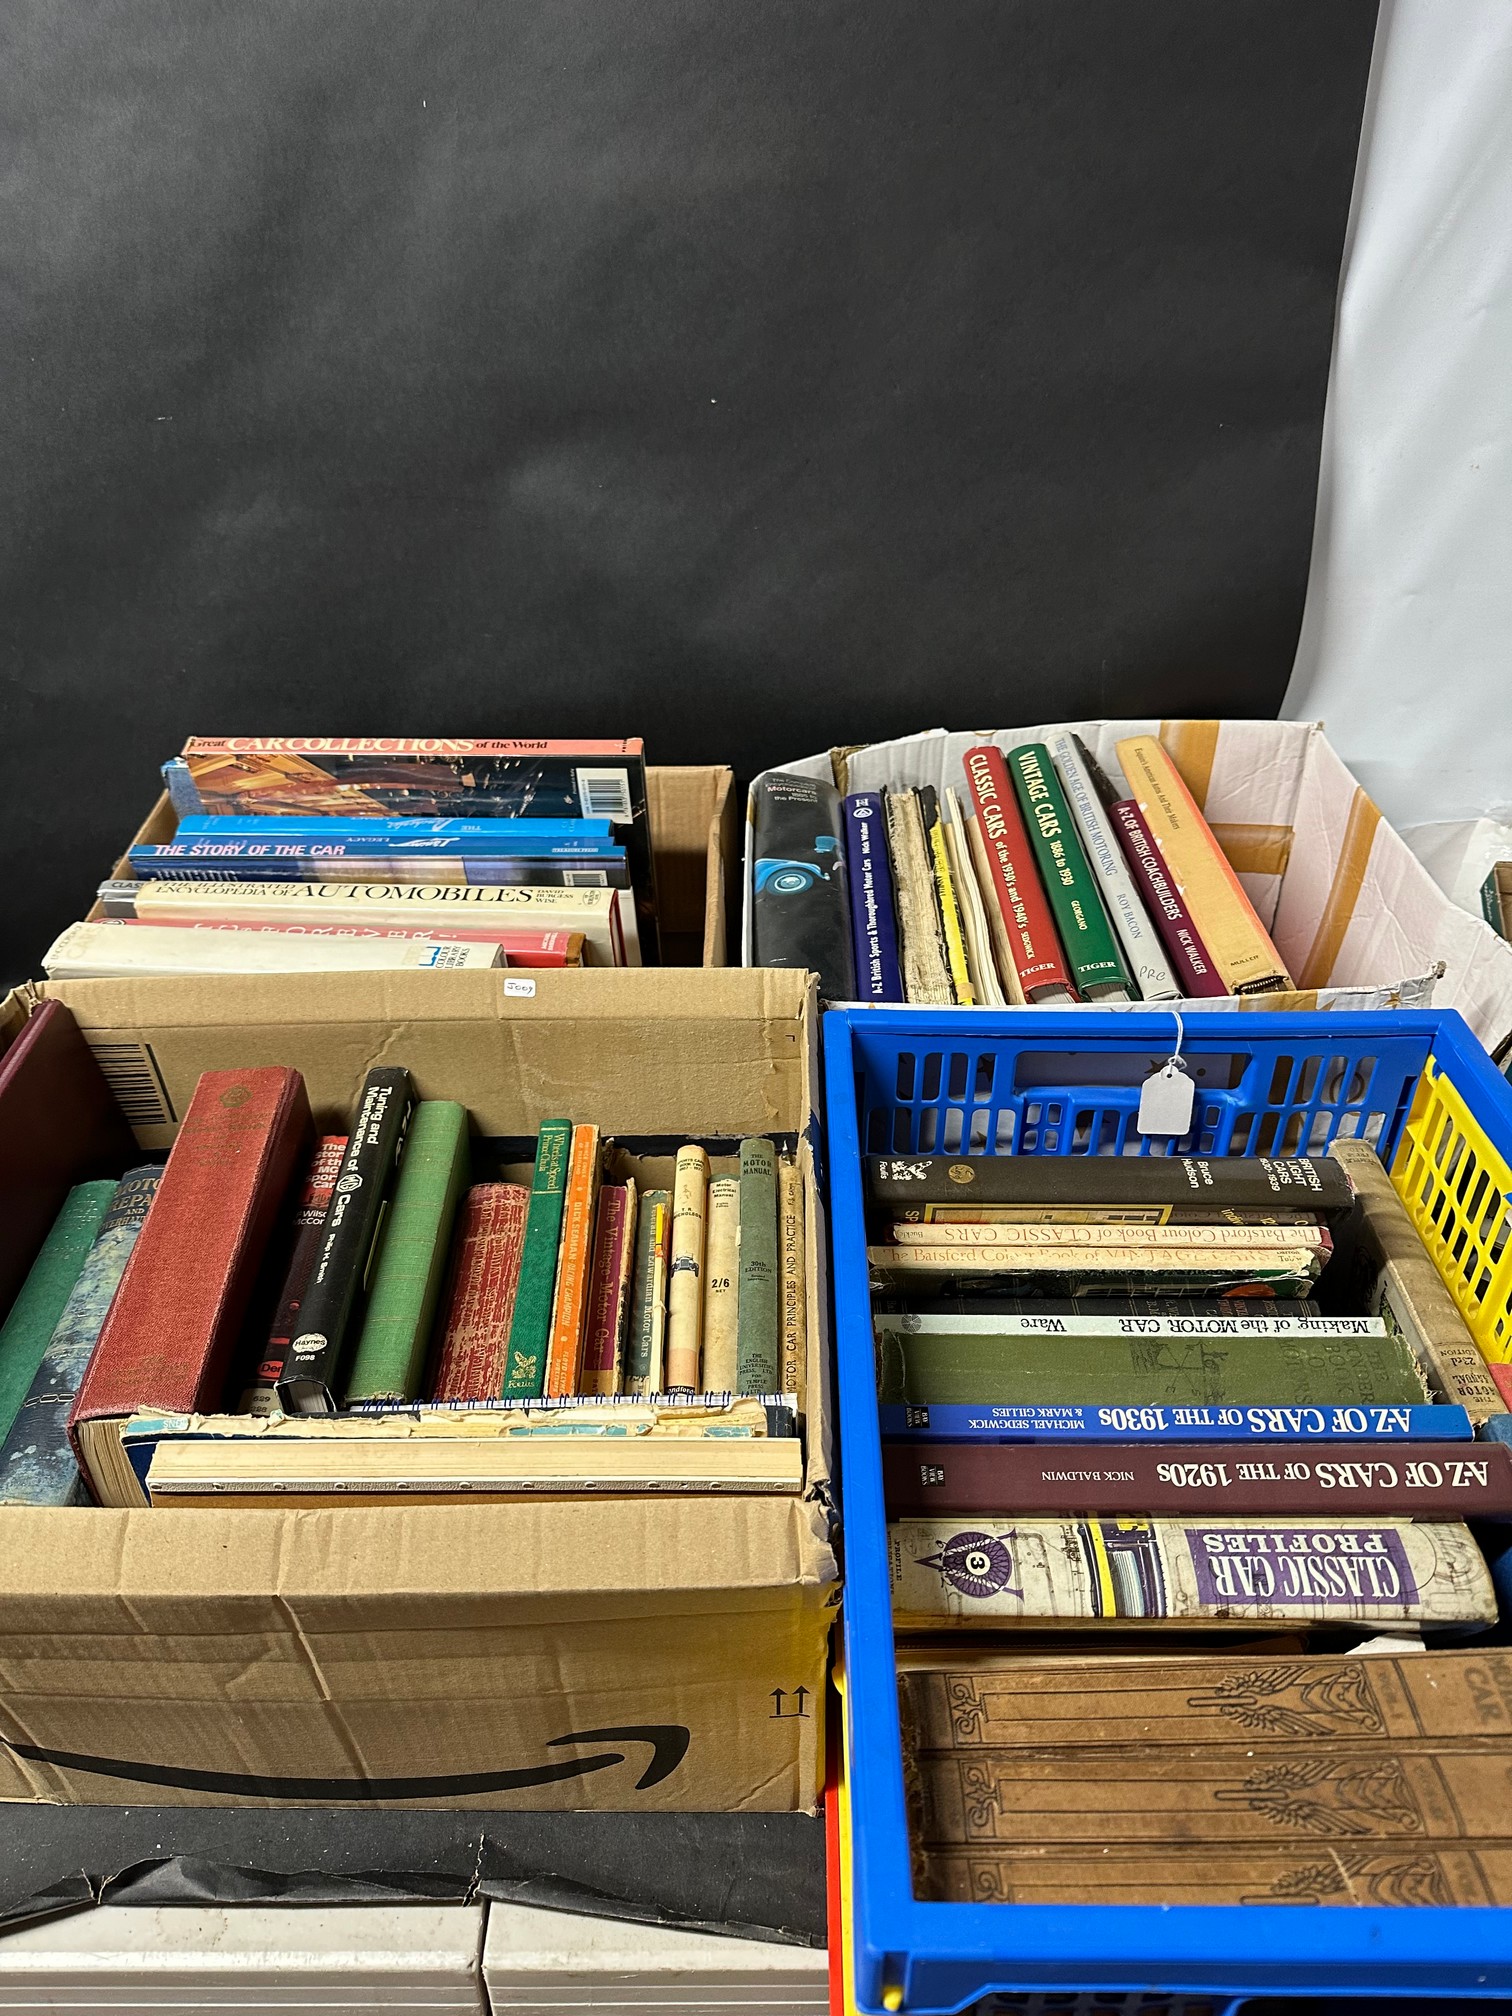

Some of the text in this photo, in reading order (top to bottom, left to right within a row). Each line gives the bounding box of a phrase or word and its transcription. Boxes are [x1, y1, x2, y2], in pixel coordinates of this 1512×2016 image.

[190, 738, 548, 752] Great CAR COLLECTIONS of the World
[767, 786, 817, 795] Motorcars
[969, 754, 998, 805] CLASSIC
[1018, 750, 1075, 887] VINTAGE CARS 1886 to 1930
[1055, 738, 1119, 877] THE GOLDEN AGE OF BRITISH MOTORING
[860, 822, 869, 841] Walker
[982, 804, 1008, 840] CARS
[155, 845, 346, 856] THE STORY OF THE CAR
[861, 840, 871, 854] Nick
[995, 841, 1008, 850] of
[997, 849, 1011, 864] the
[861, 858, 872, 871] Cars
[1001, 863, 1017, 887] 1930's
[1123, 819, 1183, 922] OF BRITISH COACHBUILDERS
[863, 872, 874, 890] Motor
[155, 886, 266, 896] ENCYCLOPEDIA
[292, 885, 534, 902] AUTOMOBILES
[1008, 887, 1022, 903] and
[864, 889, 879, 930] Thoroughbred
[1012, 902, 1029, 929] 1940's
[1070, 900, 1088, 931] GEORGANO
[1116, 893, 1143, 940] ROY BACON
[435, 946, 451, 969] COLOUR
[455, 947, 471, 967] BOOKS
[868, 936, 883, 958] Sports
[1176, 928, 1208, 976] NICK WALKER
[870, 958, 883, 982] British
[1019, 962, 1057, 978] TIGER
[1077, 961, 1117, 973] TIGER
[1229, 954, 1260, 967] MULLER
[872, 981, 884, 994] A-Z
[350, 1086, 380, 1157] Maintenance
[366, 1086, 393, 1145] Tuning and
[322, 1143, 347, 1151] The
[538, 1134, 554, 1172] Prince Chula
[551, 1133, 566, 1161] Wheels
[311, 1158, 325, 1167] of
[346, 1158, 359, 1172] of
[742, 1159, 773, 1168] MOTOR
[742, 1167, 773, 1176] MANUAL
[879, 1160, 889, 1180] Foulis
[1180, 1158, 1200, 1189] Hudson
[1197, 1161, 1214, 1186] Bruce
[1272, 1160, 1293, 1185] CARS
[1285, 1160, 1308, 1187] LIGHT
[547, 1165, 561, 1190] Speed
[1298, 1158, 1324, 1191] BRITISH
[125, 1208, 146, 1216] AND
[331, 1193, 352, 1228] Cars
[607, 1199, 621, 1223] The
[944, 1227, 1320, 1242] The Batsford Colour Book of CLASSIC CARS
[316, 1233, 336, 1285] Philip H. Smith
[561, 1201, 583, 1327] DICK RACING CHAMPION
[914, 1247, 976, 1262] Batsford
[745, 1266, 773, 1274] EDITION
[712, 1277, 731, 1289] 2/6
[596, 1281, 614, 1320] Motor
[785, 1214, 797, 1394] MOTOR CAR PRINCIPLES AND PRACTICE
[640, 1304, 654, 1359] Motor Cars
[1020, 1318, 1068, 1332] Ware
[1118, 1317, 1370, 1334] Making of the MOTOR CAR
[294, 1339, 326, 1347] Haynes
[593, 1327, 611, 1352] Car
[1440, 1349, 1477, 1357] EDITION
[1450, 1357, 1477, 1367] 23rd
[1321, 1343, 1355, 1396] BOOK
[991, 1407, 1083, 1418] & MARK GILLIES
[1098, 1407, 1411, 1432] A-Z OF CARS OF THE 1930s
[968, 1419, 1086, 1430] MICHAEL SEDGWICK
[1041, 1471, 1135, 1481] NICK BALDWIN
[1156, 1460, 1490, 1488] A-Z OF CARS OF THE 1920s
[1201, 1533, 1389, 1553] PROFILES
[894, 1539, 903, 1582] PROFILE
[970, 1556, 986, 1570] 3
[1208, 1555, 1401, 1598] CLASSIC CAR
[1463, 1666, 1500, 1727] CAR
